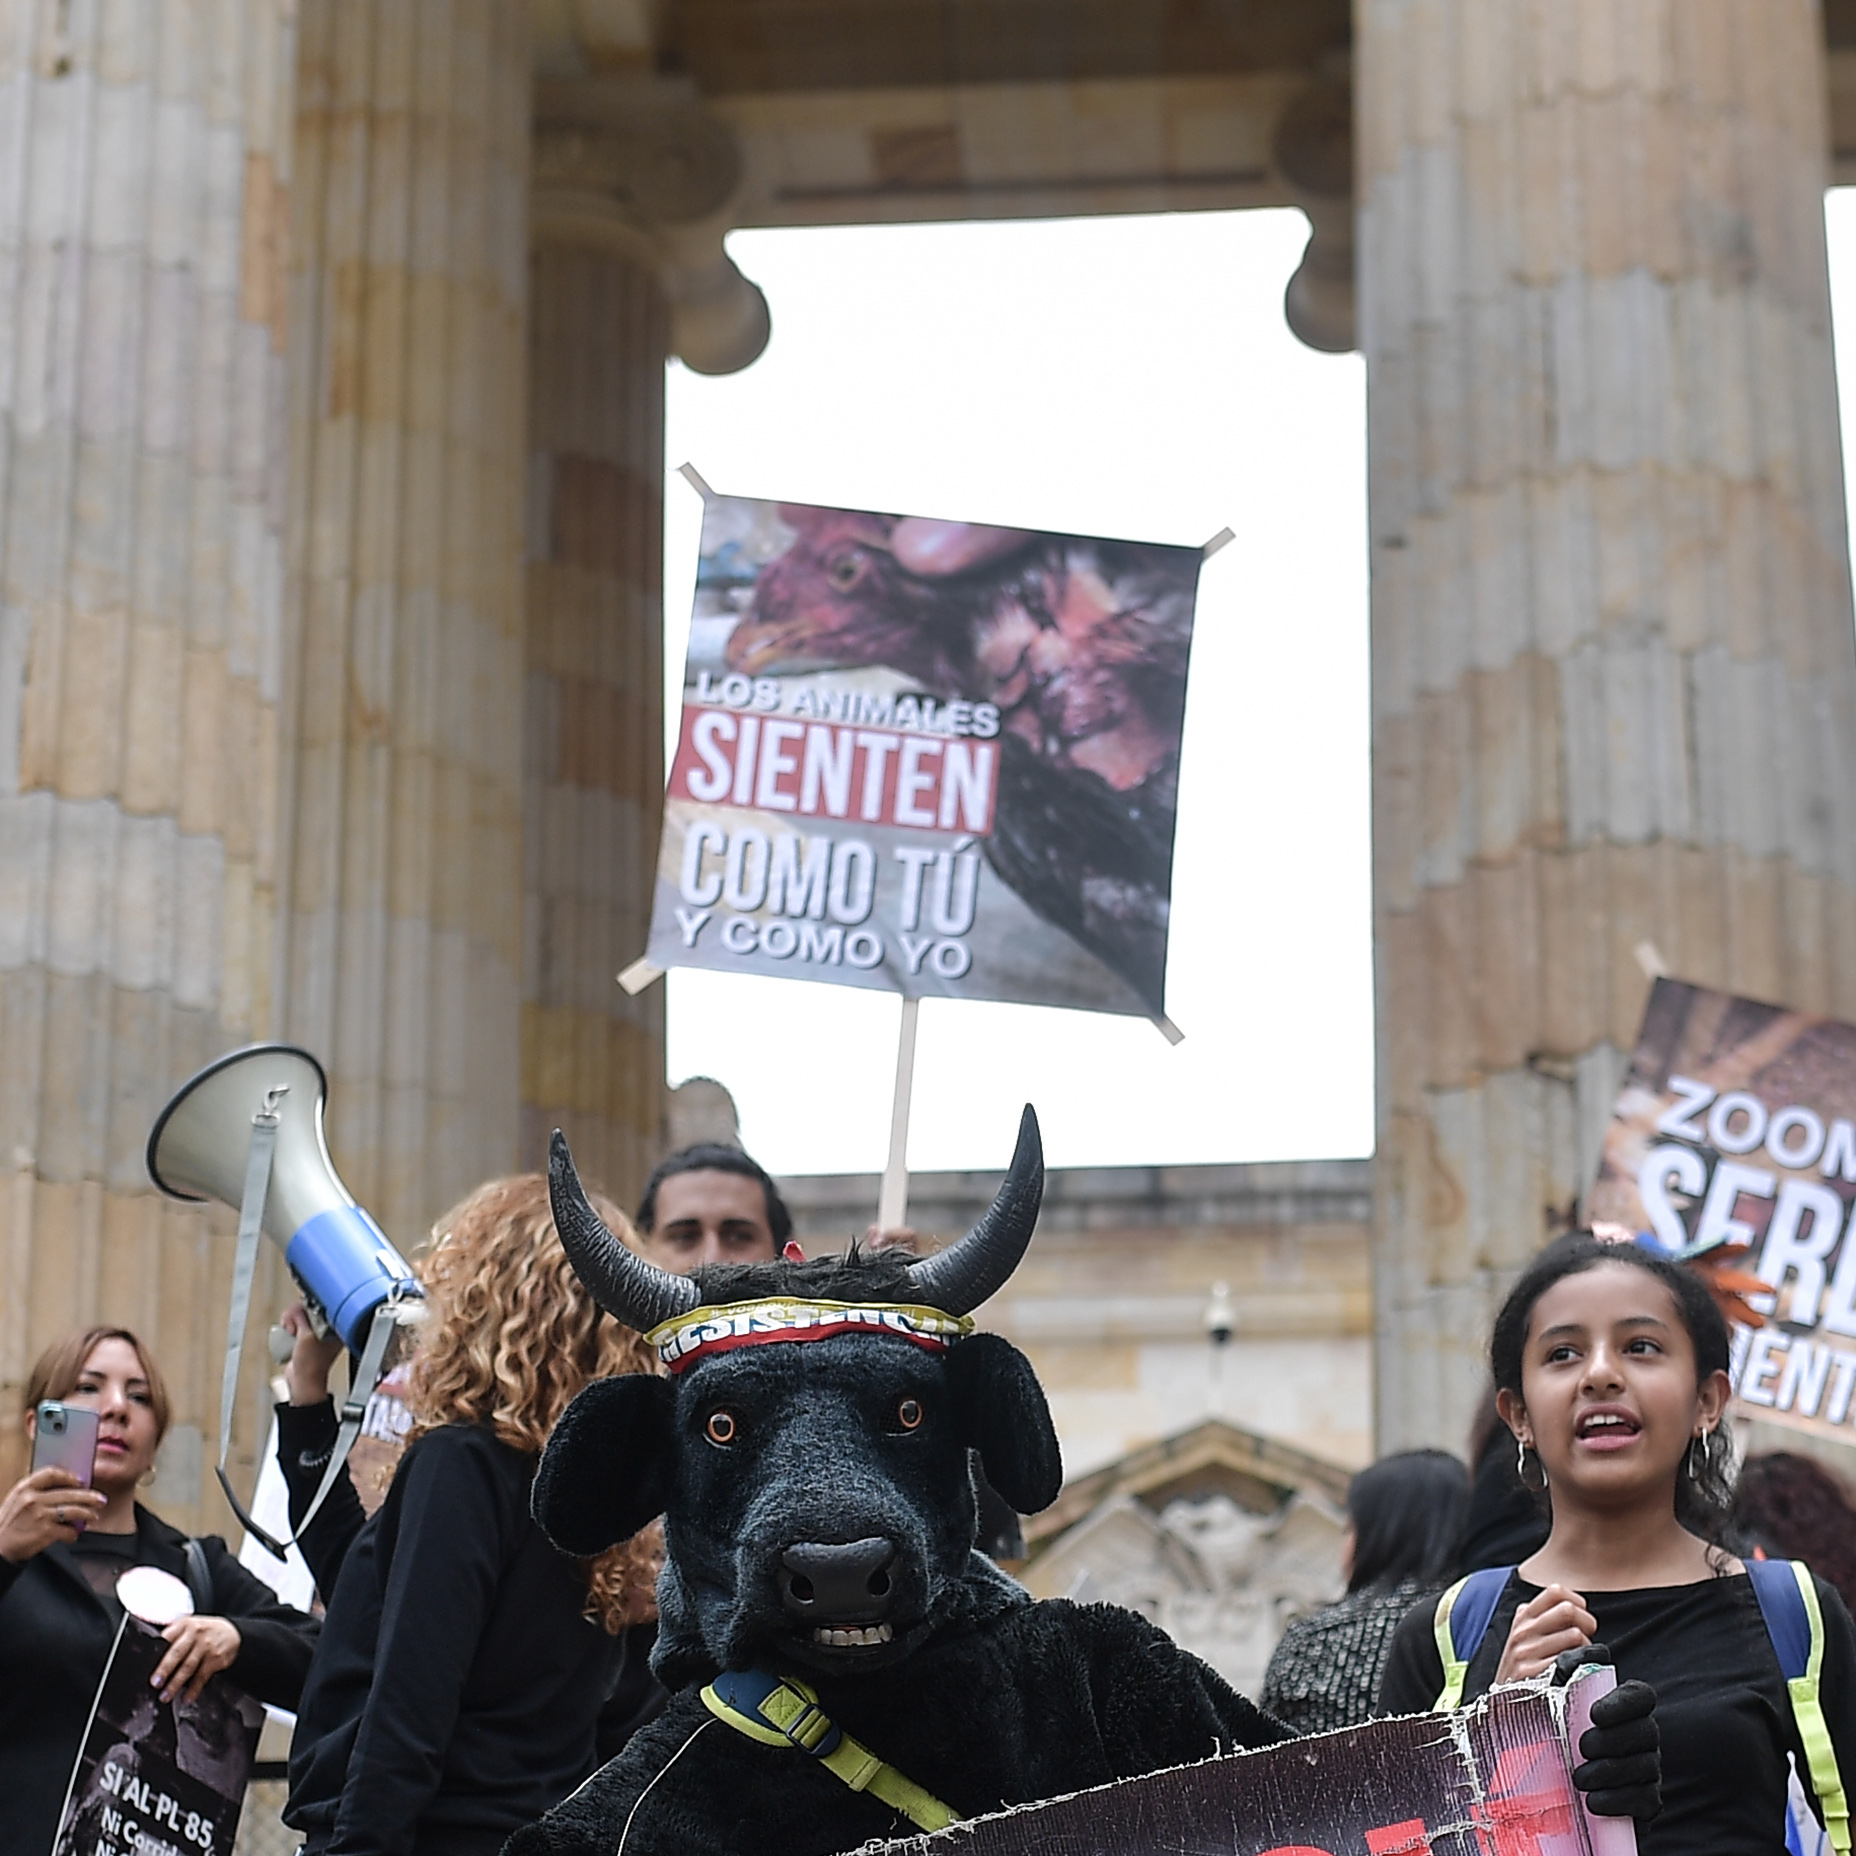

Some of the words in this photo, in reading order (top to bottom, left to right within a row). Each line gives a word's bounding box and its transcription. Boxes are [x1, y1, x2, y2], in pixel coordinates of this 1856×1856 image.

[698, 670, 781, 711] LOS
[795, 686, 1000, 737] ANIMALES
[686, 711, 993, 832] SIENTEN
[680, 820, 876, 925] COMO
[896, 836, 980, 936] TÚ
[675, 906, 710, 947] Y
[721, 917, 884, 969] COMO
[900, 935, 972, 979] YO
[99, 1760, 124, 1796] SI
[122, 1776, 151, 1815] AL
[154, 1792, 180, 1832] PL
[184, 1811, 214, 1848] 85
[101, 1806, 123, 1836] Ni
